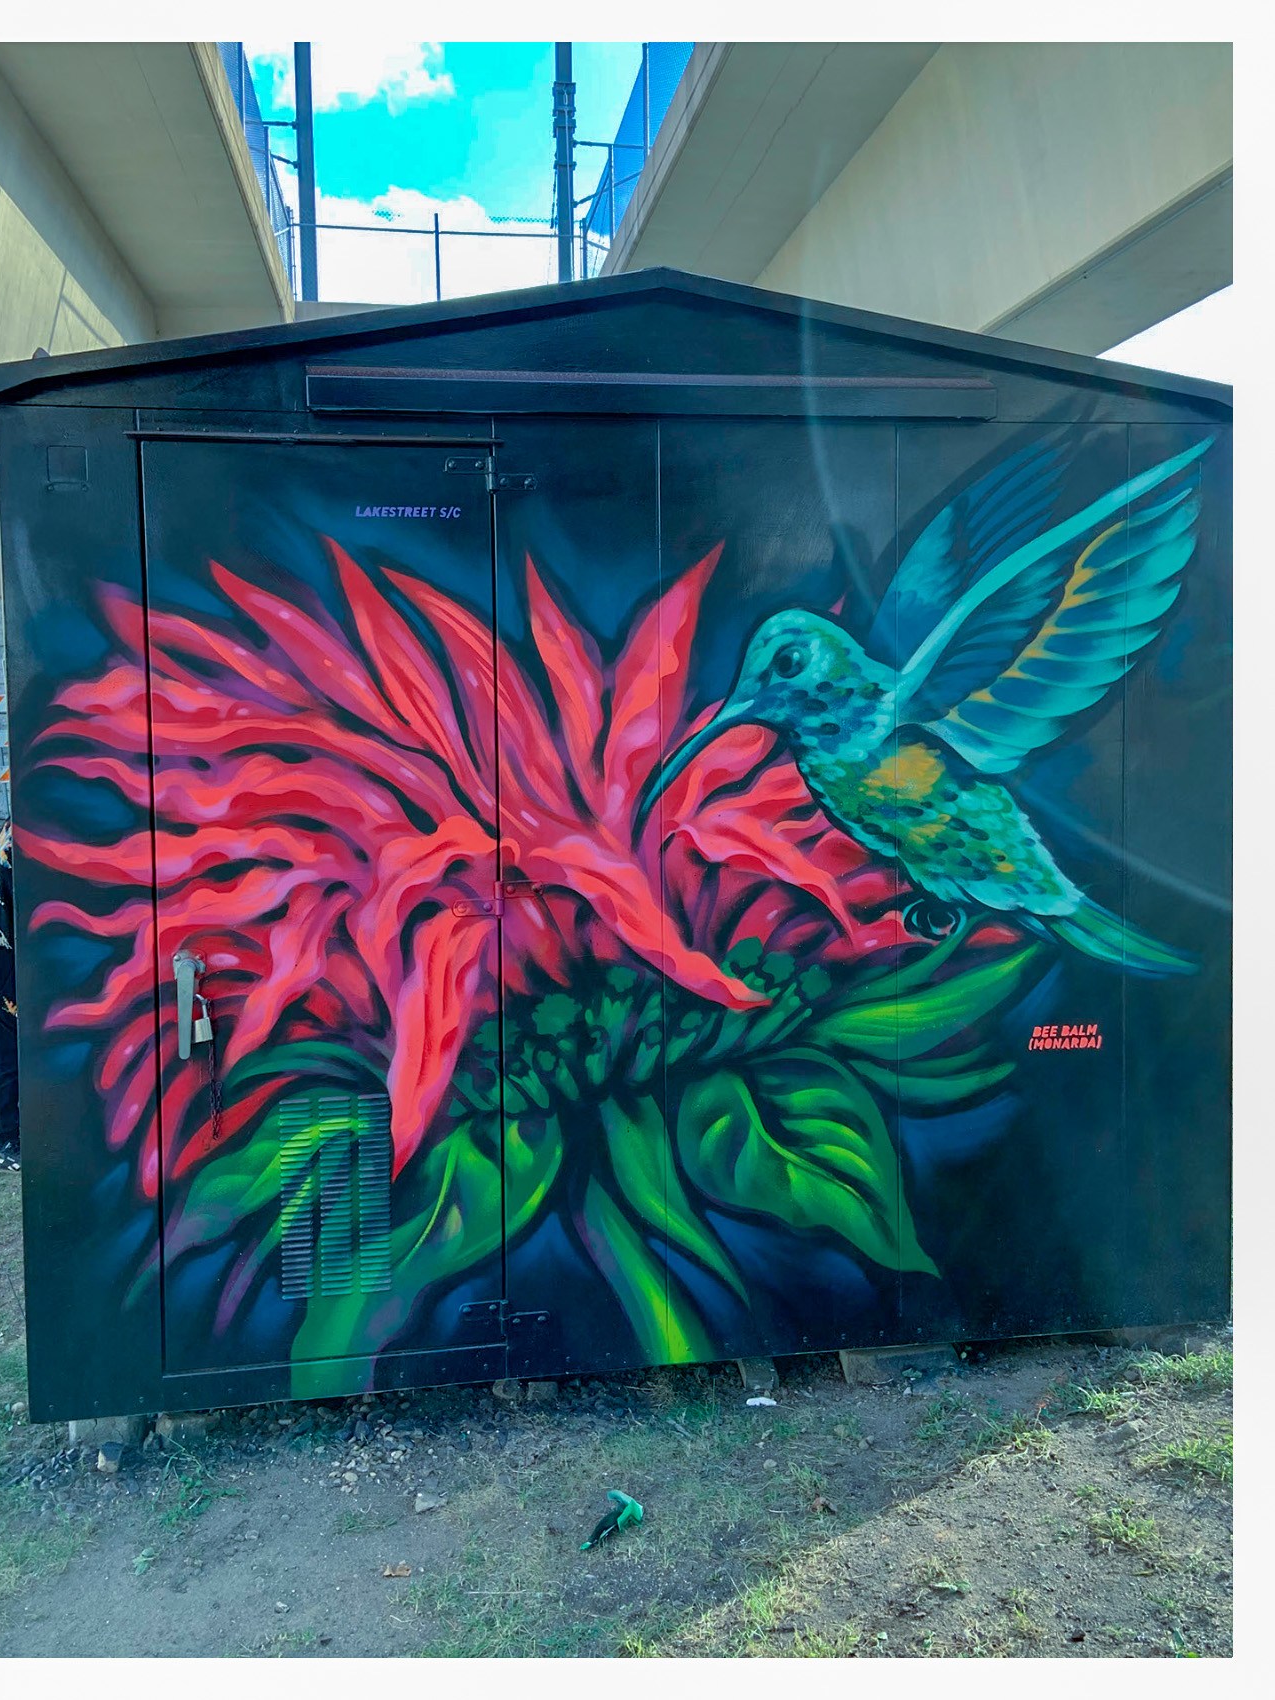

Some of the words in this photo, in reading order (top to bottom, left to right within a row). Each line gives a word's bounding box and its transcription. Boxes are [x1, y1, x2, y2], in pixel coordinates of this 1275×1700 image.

[355, 505, 437, 518] LAKESTREET
[439, 505, 462, 519] S/C
[1032, 1025, 1059, 1038] BEE
[1061, 1024, 1098, 1037] BALM
[1028, 1034, 1103, 1051] (MONARDA)
